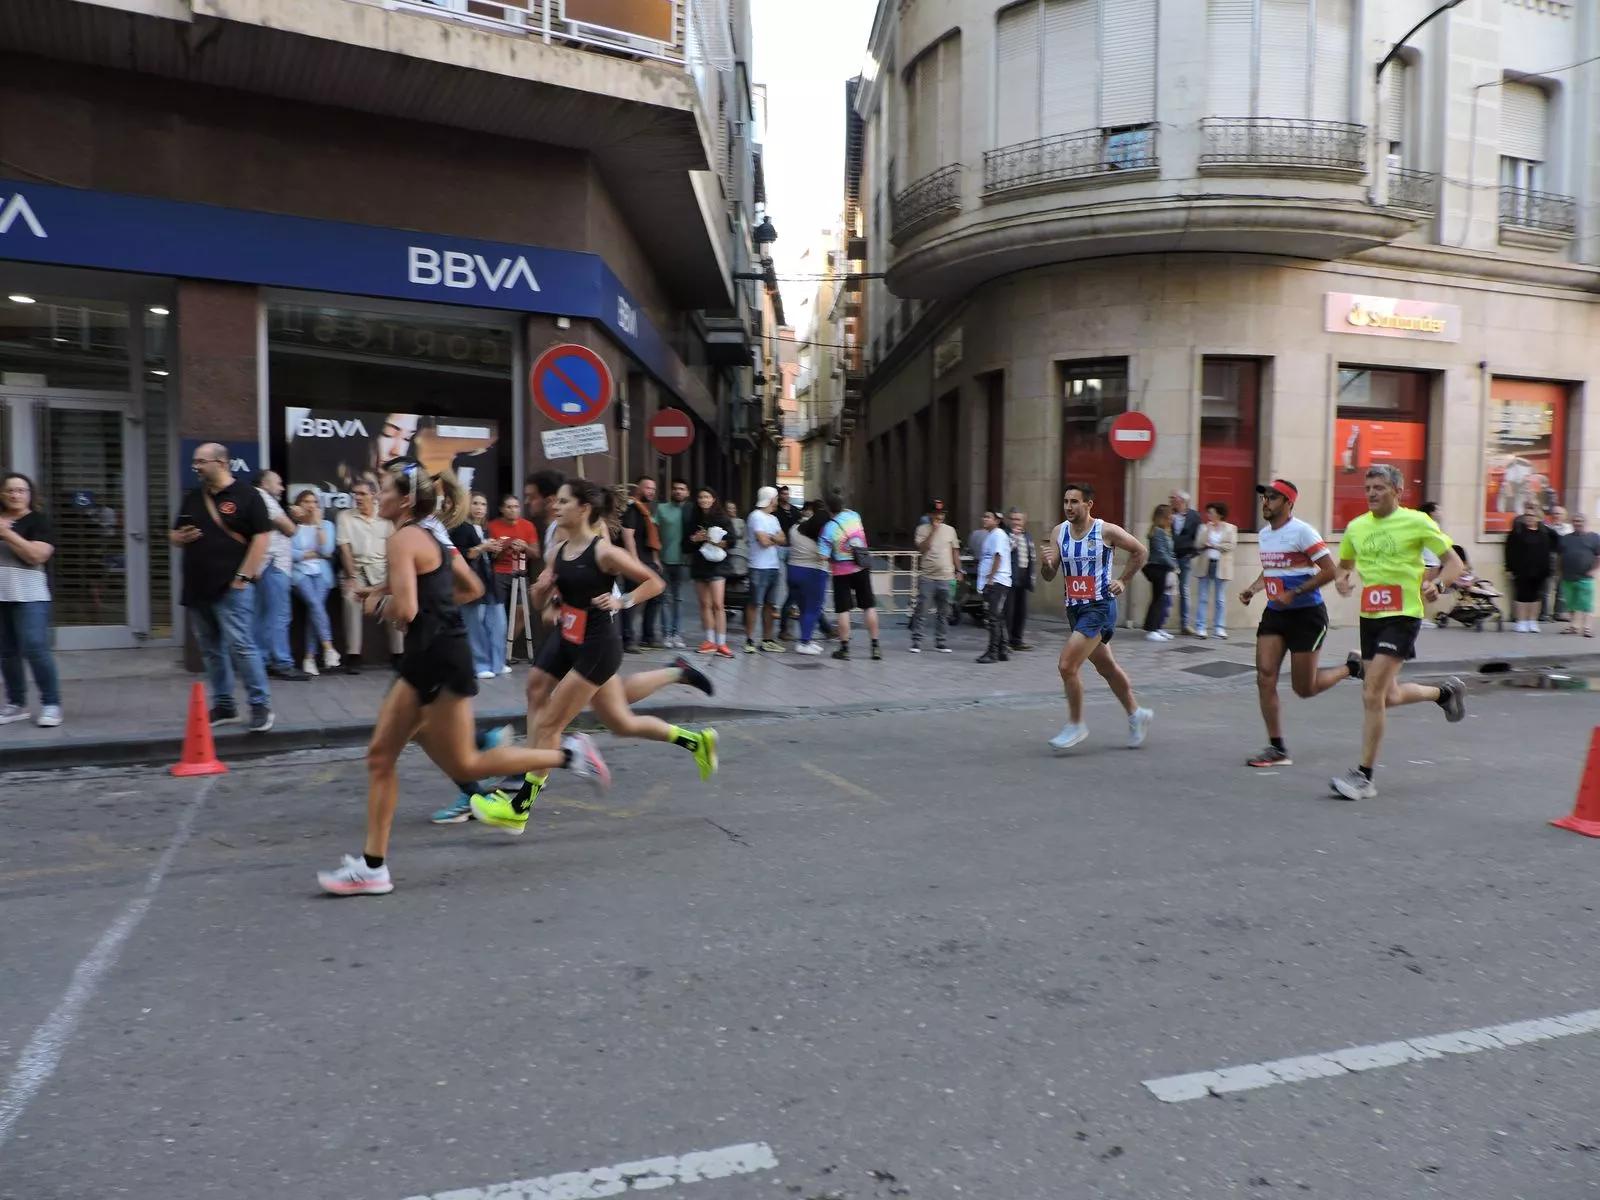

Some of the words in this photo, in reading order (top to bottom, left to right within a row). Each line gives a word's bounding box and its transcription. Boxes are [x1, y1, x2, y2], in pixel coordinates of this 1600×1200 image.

[408, 246, 541, 292] BBVA
[297, 418, 369, 438] BBVA
[1072, 580, 1088, 593] 04
[1369, 589, 1392, 605] 05
